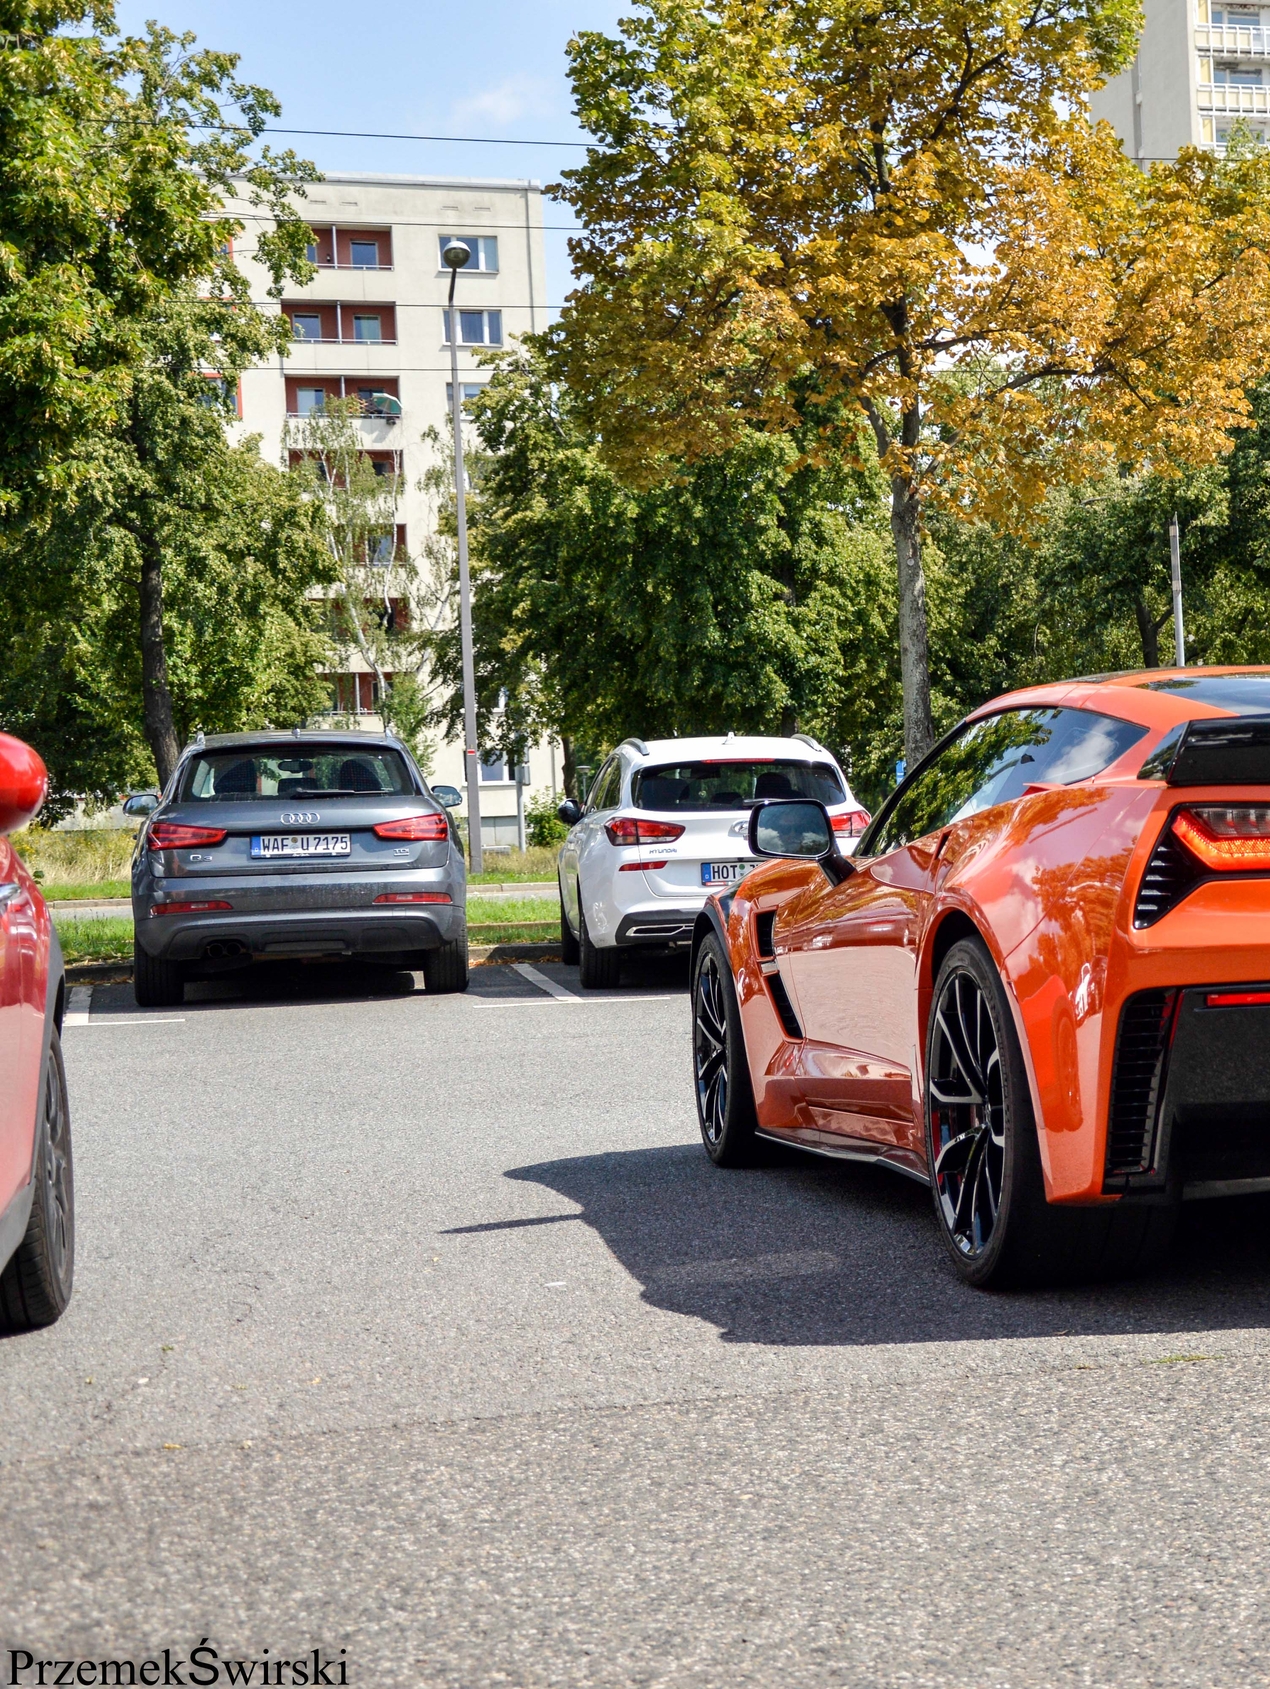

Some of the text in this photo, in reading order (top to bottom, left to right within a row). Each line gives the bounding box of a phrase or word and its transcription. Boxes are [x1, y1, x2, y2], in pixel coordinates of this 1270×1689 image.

[262, 837, 289, 853] WAF
[301, 836, 310, 851] U
[313, 835, 348, 851] 7175
[190, 854, 213, 862] Q3
[712, 865, 737, 880] HOT
